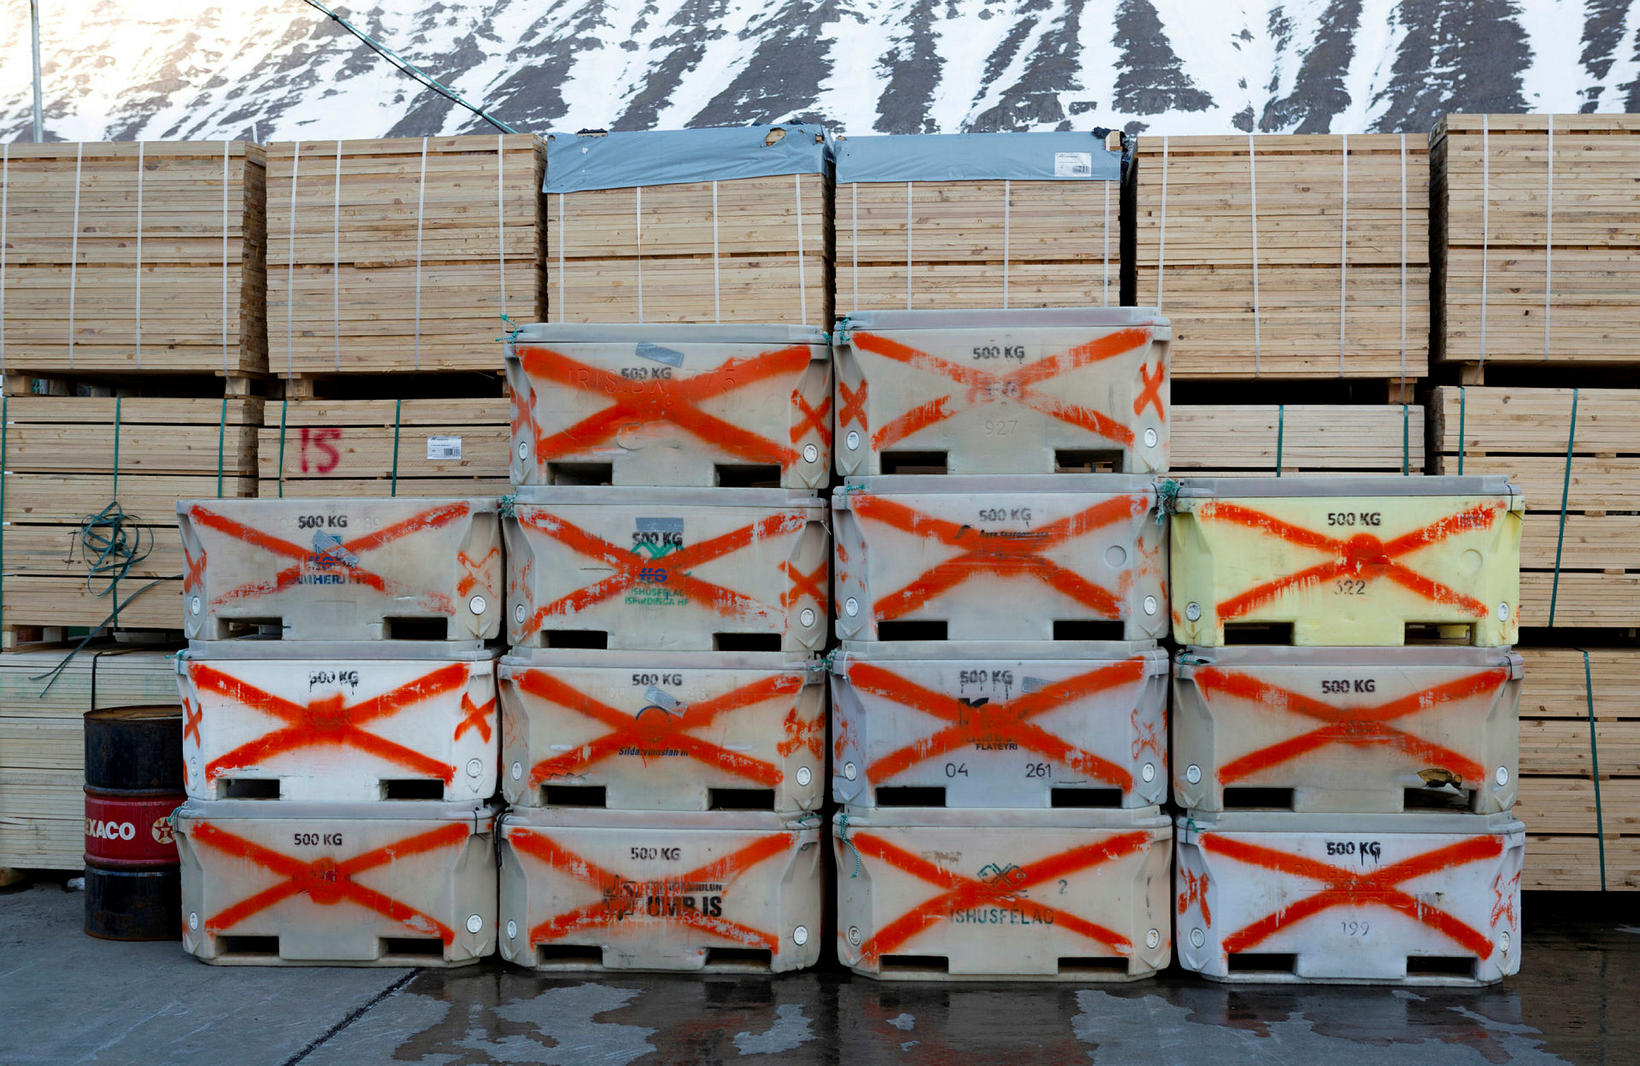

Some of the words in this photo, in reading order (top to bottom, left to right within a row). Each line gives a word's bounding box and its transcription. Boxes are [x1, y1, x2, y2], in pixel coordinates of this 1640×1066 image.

[973, 346, 1000, 360] 500
[1004, 346, 1025, 360] KG
[621, 367, 648, 381] 500
[651, 367, 673, 380] KG
[984, 419, 1018, 436] 927
[979, 508, 1007, 521] 500
[1010, 508, 1032, 521] KG
[1328, 512, 1356, 526] 500
[1360, 512, 1381, 526] KG
[298, 515, 324, 529] 500
[327, 515, 348, 528] KG
[662, 532, 683, 547] KG
[339, 670, 359, 687] KG
[632, 674, 659, 686] 500
[662, 674, 682, 686] KG
[960, 670, 988, 684] 500
[992, 670, 1013, 685] KG
[1322, 680, 1350, 694] 500
[1354, 679, 1376, 693] KG
[976, 743, 1018, 751] FLATEYRI
[945, 763, 969, 778] 04
[1025, 763, 1052, 778] 261
[294, 833, 319, 846] 500
[323, 833, 343, 846] KG
[631, 847, 657, 860] 500
[660, 847, 681, 860] KG
[1327, 842, 1355, 856] 500
[1359, 842, 1381, 858] KG
[1341, 920, 1370, 936] 199
